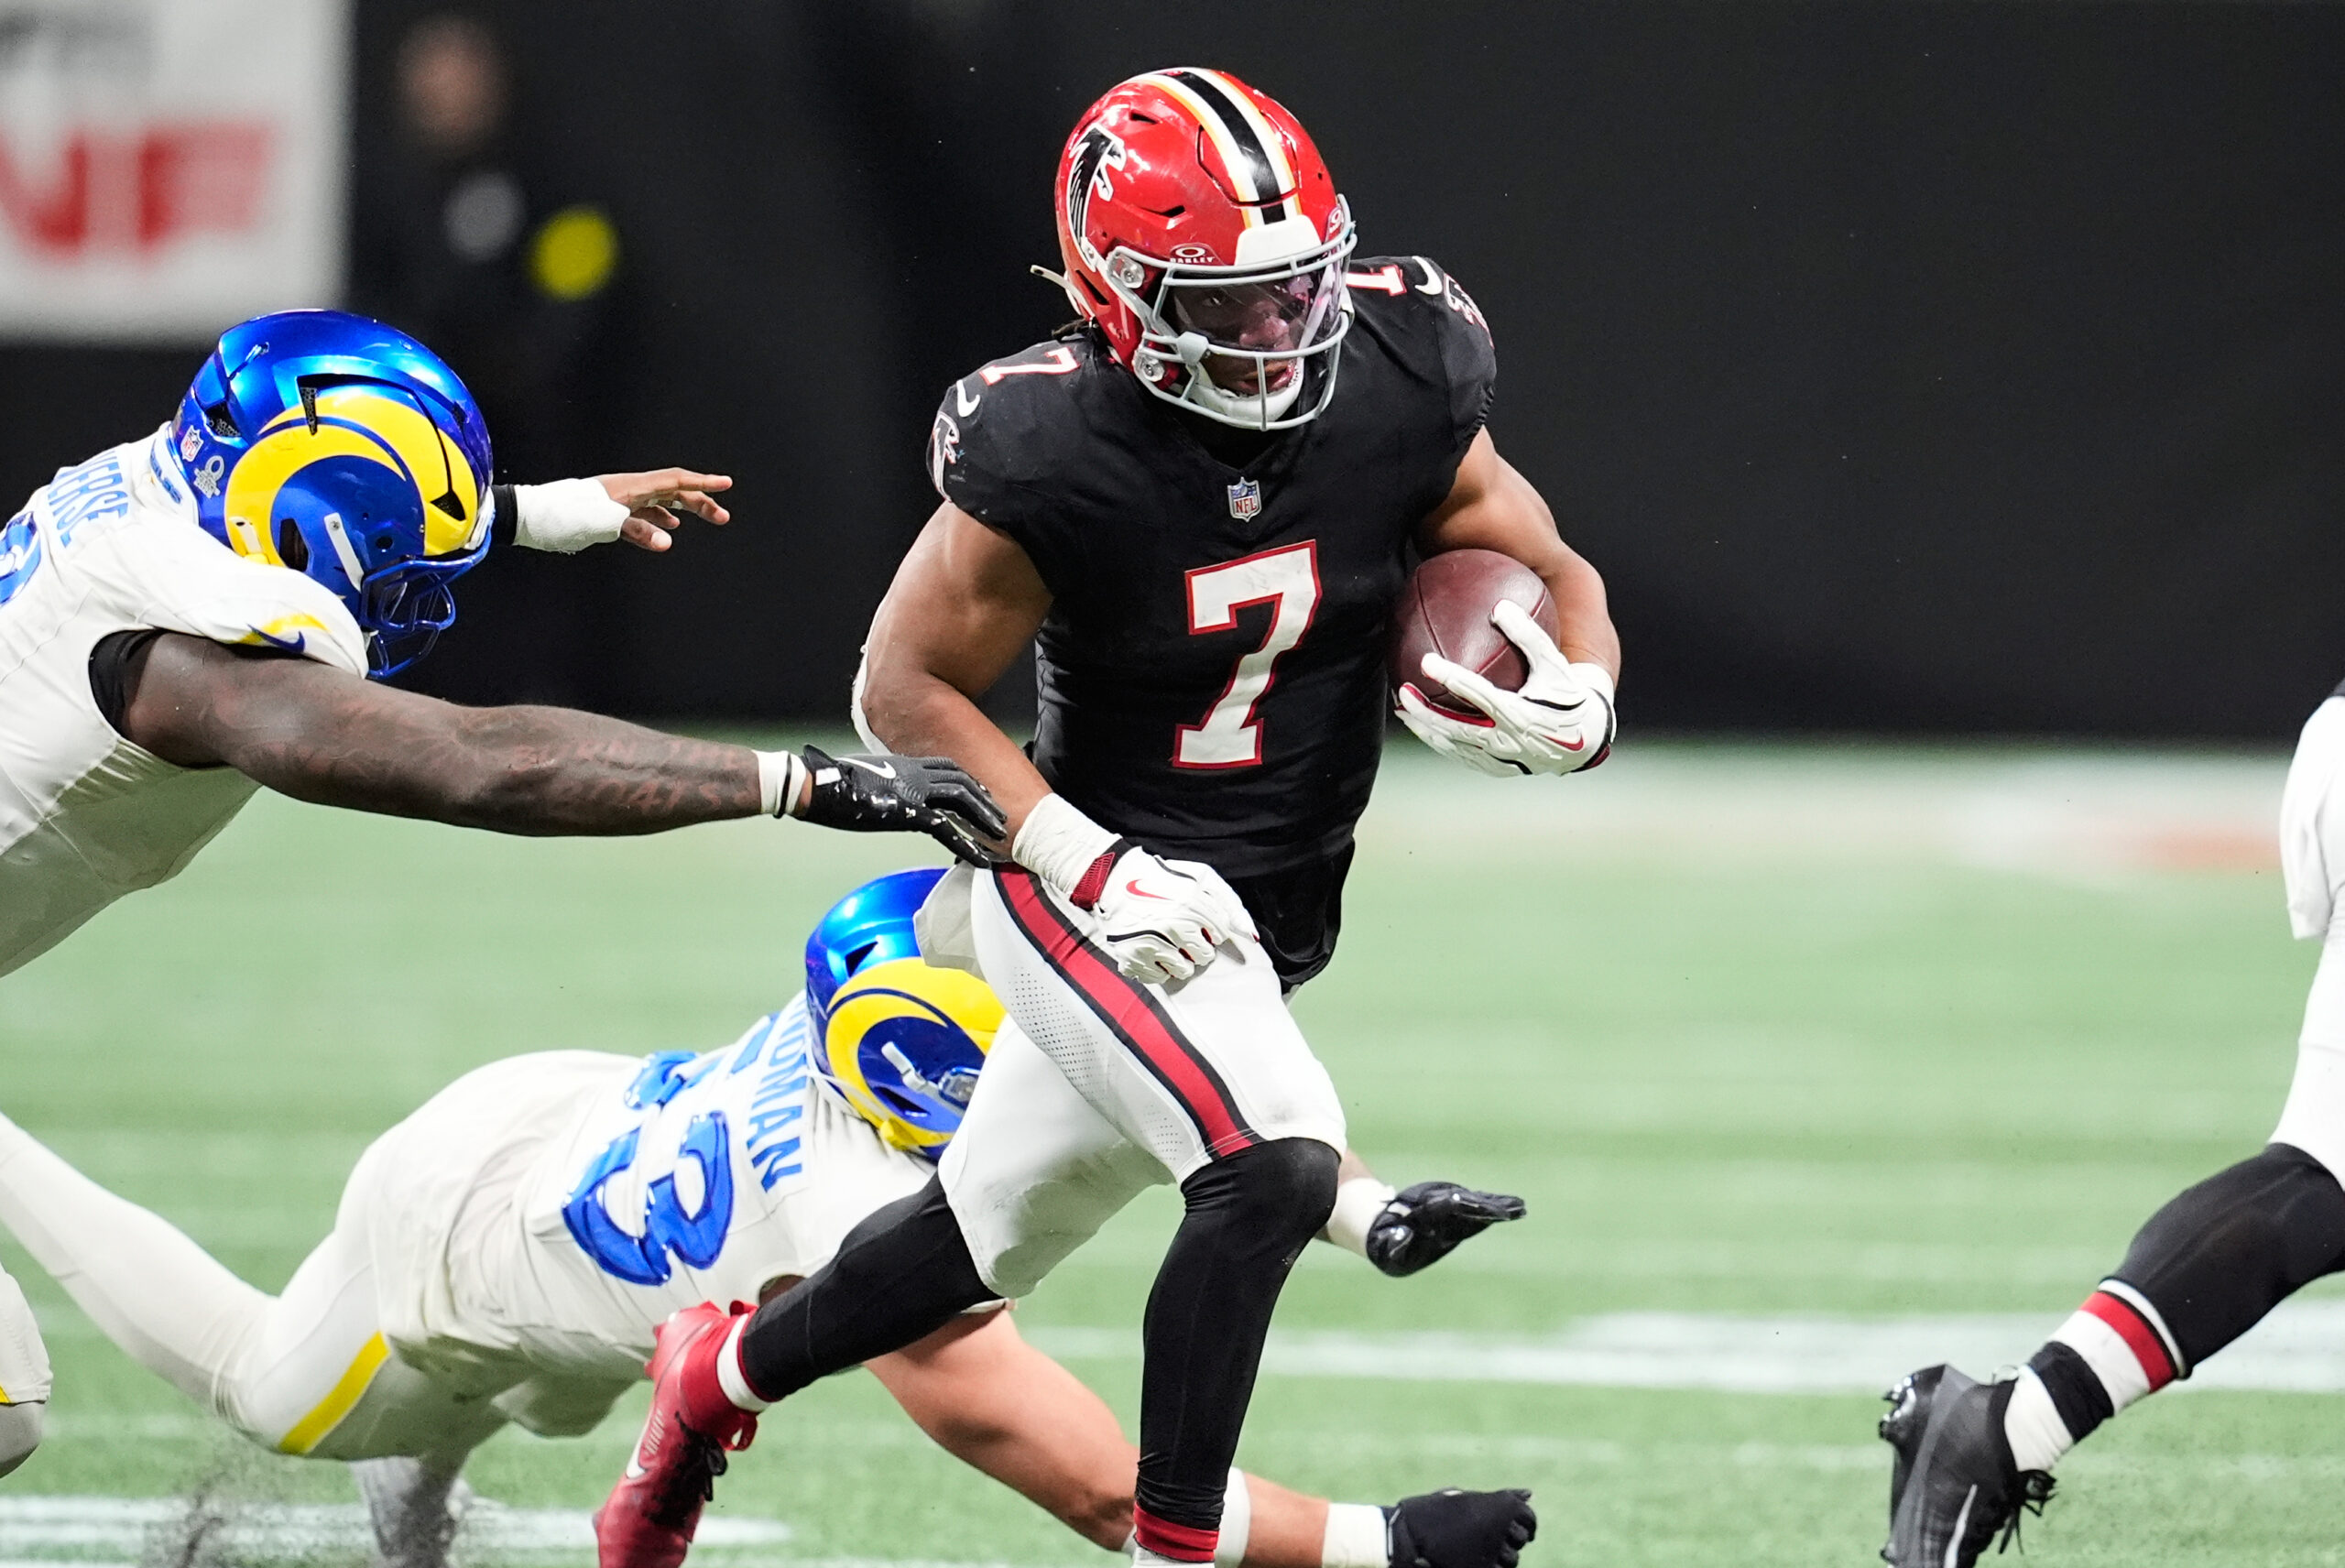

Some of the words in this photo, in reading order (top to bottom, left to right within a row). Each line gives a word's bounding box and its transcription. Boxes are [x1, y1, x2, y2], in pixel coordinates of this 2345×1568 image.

[1235, 497, 1258, 514] NFL
[1172, 539, 1323, 770] 7
[746, 996, 810, 1194] NDMAN
